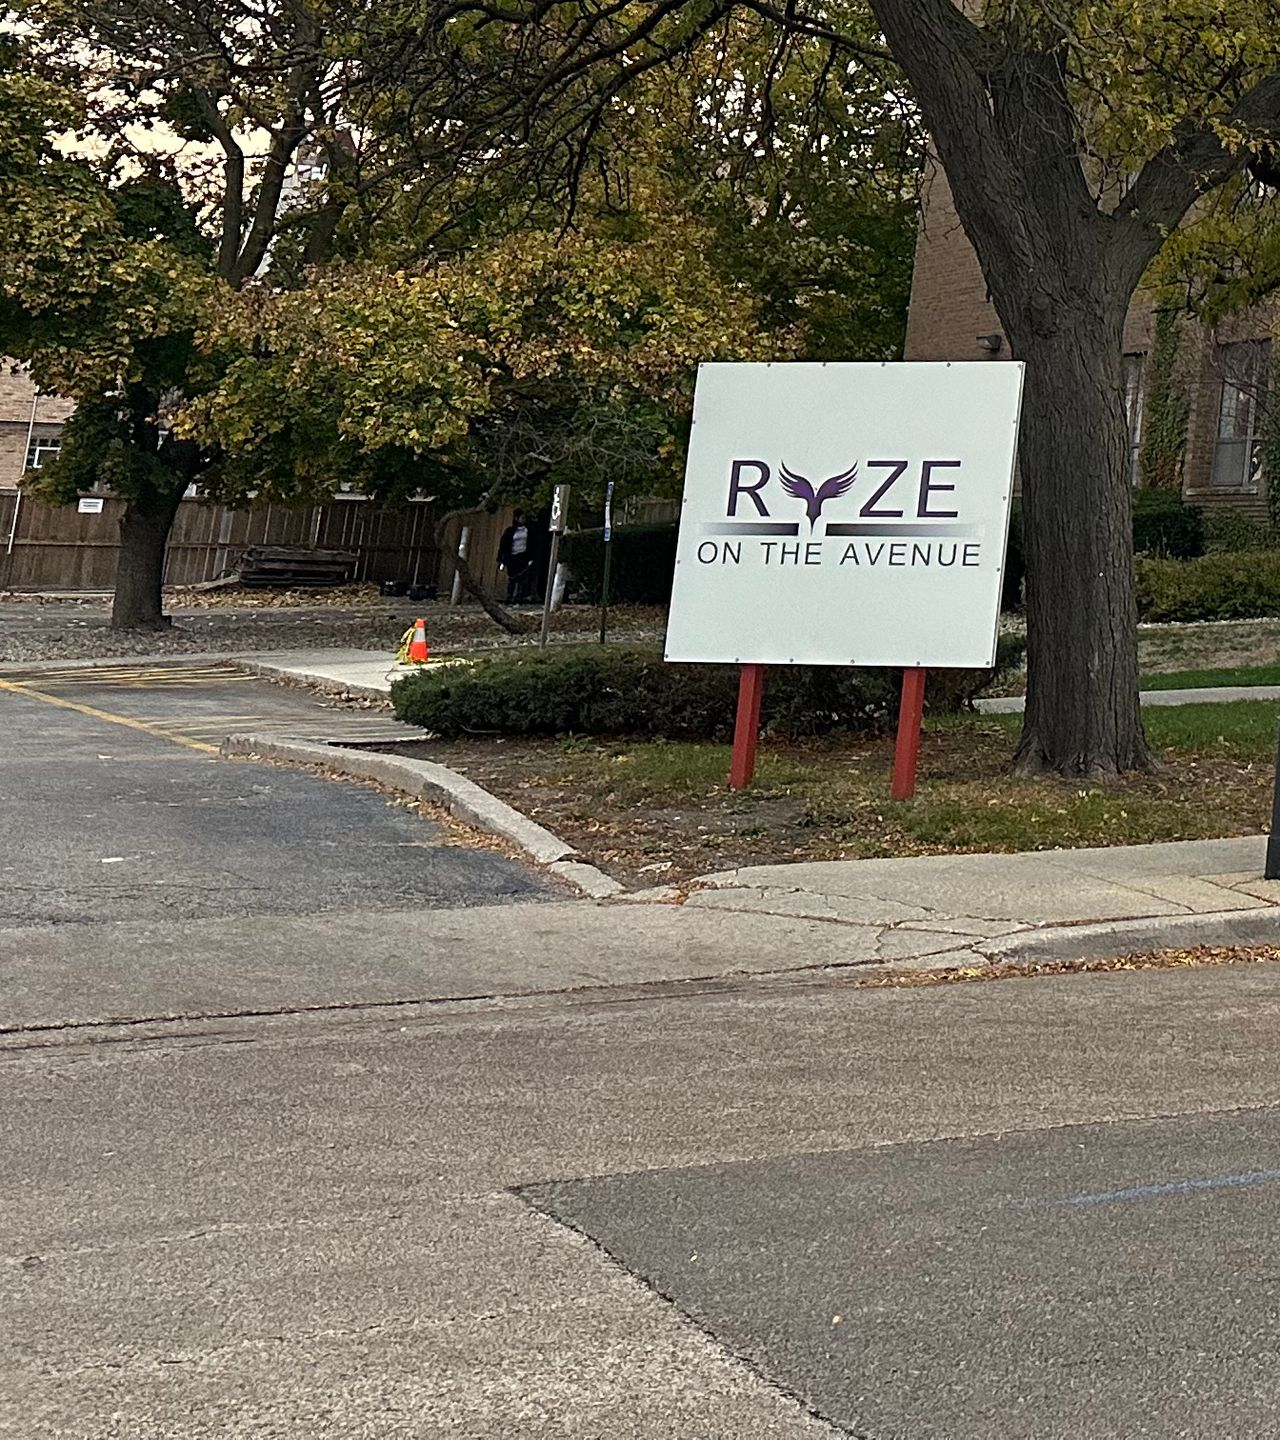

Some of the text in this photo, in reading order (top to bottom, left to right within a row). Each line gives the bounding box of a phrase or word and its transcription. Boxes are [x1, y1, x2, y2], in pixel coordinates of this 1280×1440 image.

[726, 458, 962, 534] RYZE
[697, 541, 982, 567] ON THE AVENUE
